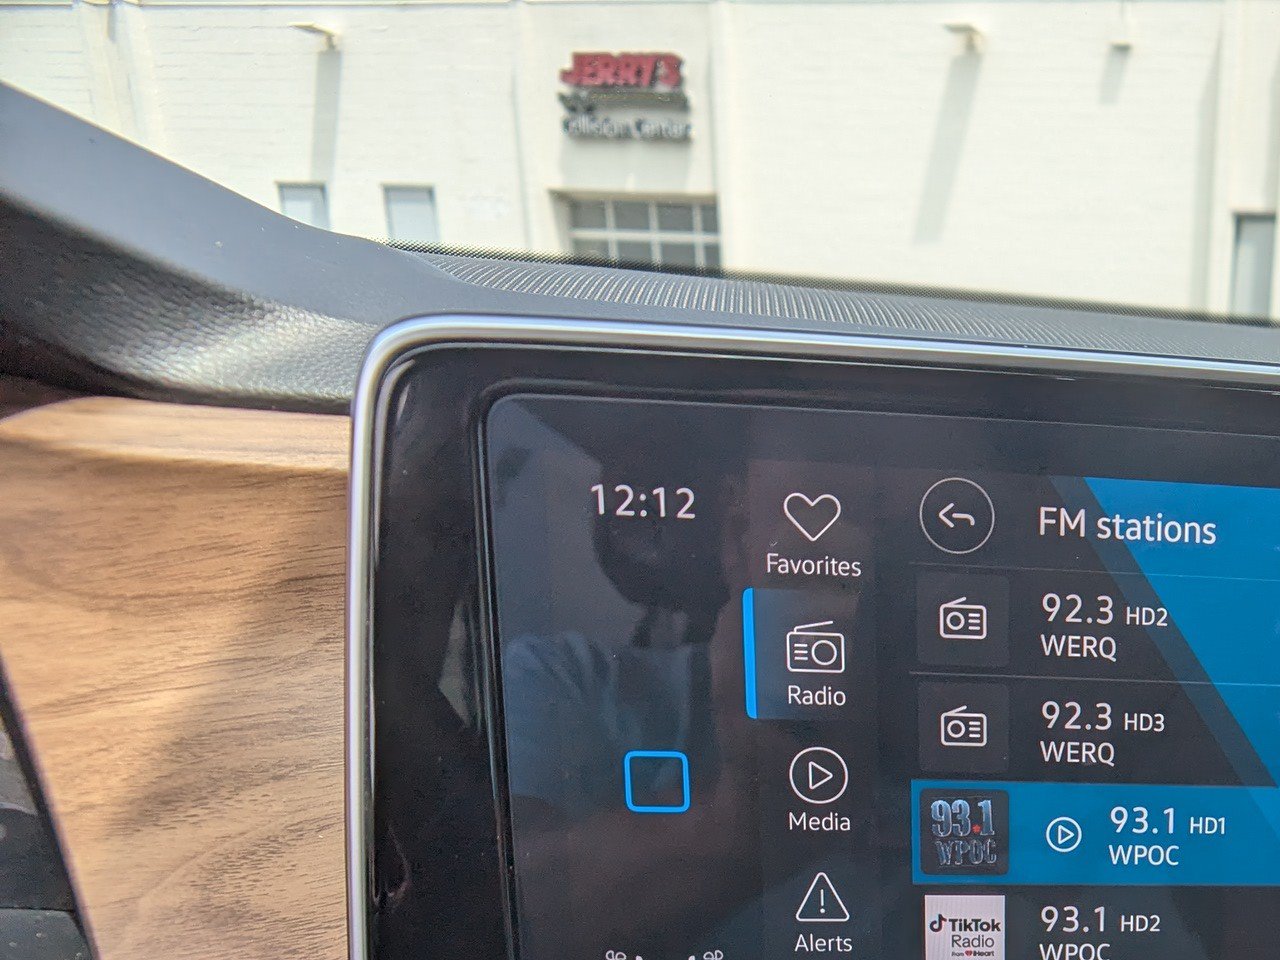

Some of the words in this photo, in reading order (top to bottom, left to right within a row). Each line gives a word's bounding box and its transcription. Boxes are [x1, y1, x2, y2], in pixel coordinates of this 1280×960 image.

[590, 483, 696, 520] 12:12
[1038, 505, 1086, 538] FM
[1096, 512, 1218, 545] stations
[765, 552, 862, 577] Favorites
[1041, 592, 1115, 625] 92.3
[1125, 606, 1169, 627] HD2
[1040, 633, 1118, 662] WERQ
[787, 684, 847, 706] Radio
[1041, 700, 1113, 732] 92.3
[1123, 712, 1166, 733] HD3
[1039, 740, 1116, 767] WERQ
[788, 811, 851, 831] Media
[930, 798, 996, 838] 93.1
[1110, 806, 1176, 835] 93.1
[1188, 816, 1226, 835] HD1
[934, 839, 998, 867] WPOC
[1108, 844, 1180, 867] WPOC
[948, 918, 1002, 932] TikTok
[1040, 905, 1107, 933] 93.1
[1120, 914, 1161, 932] HD2
[794, 933, 853, 952] Alerts
[951, 934, 996, 948] Radio
